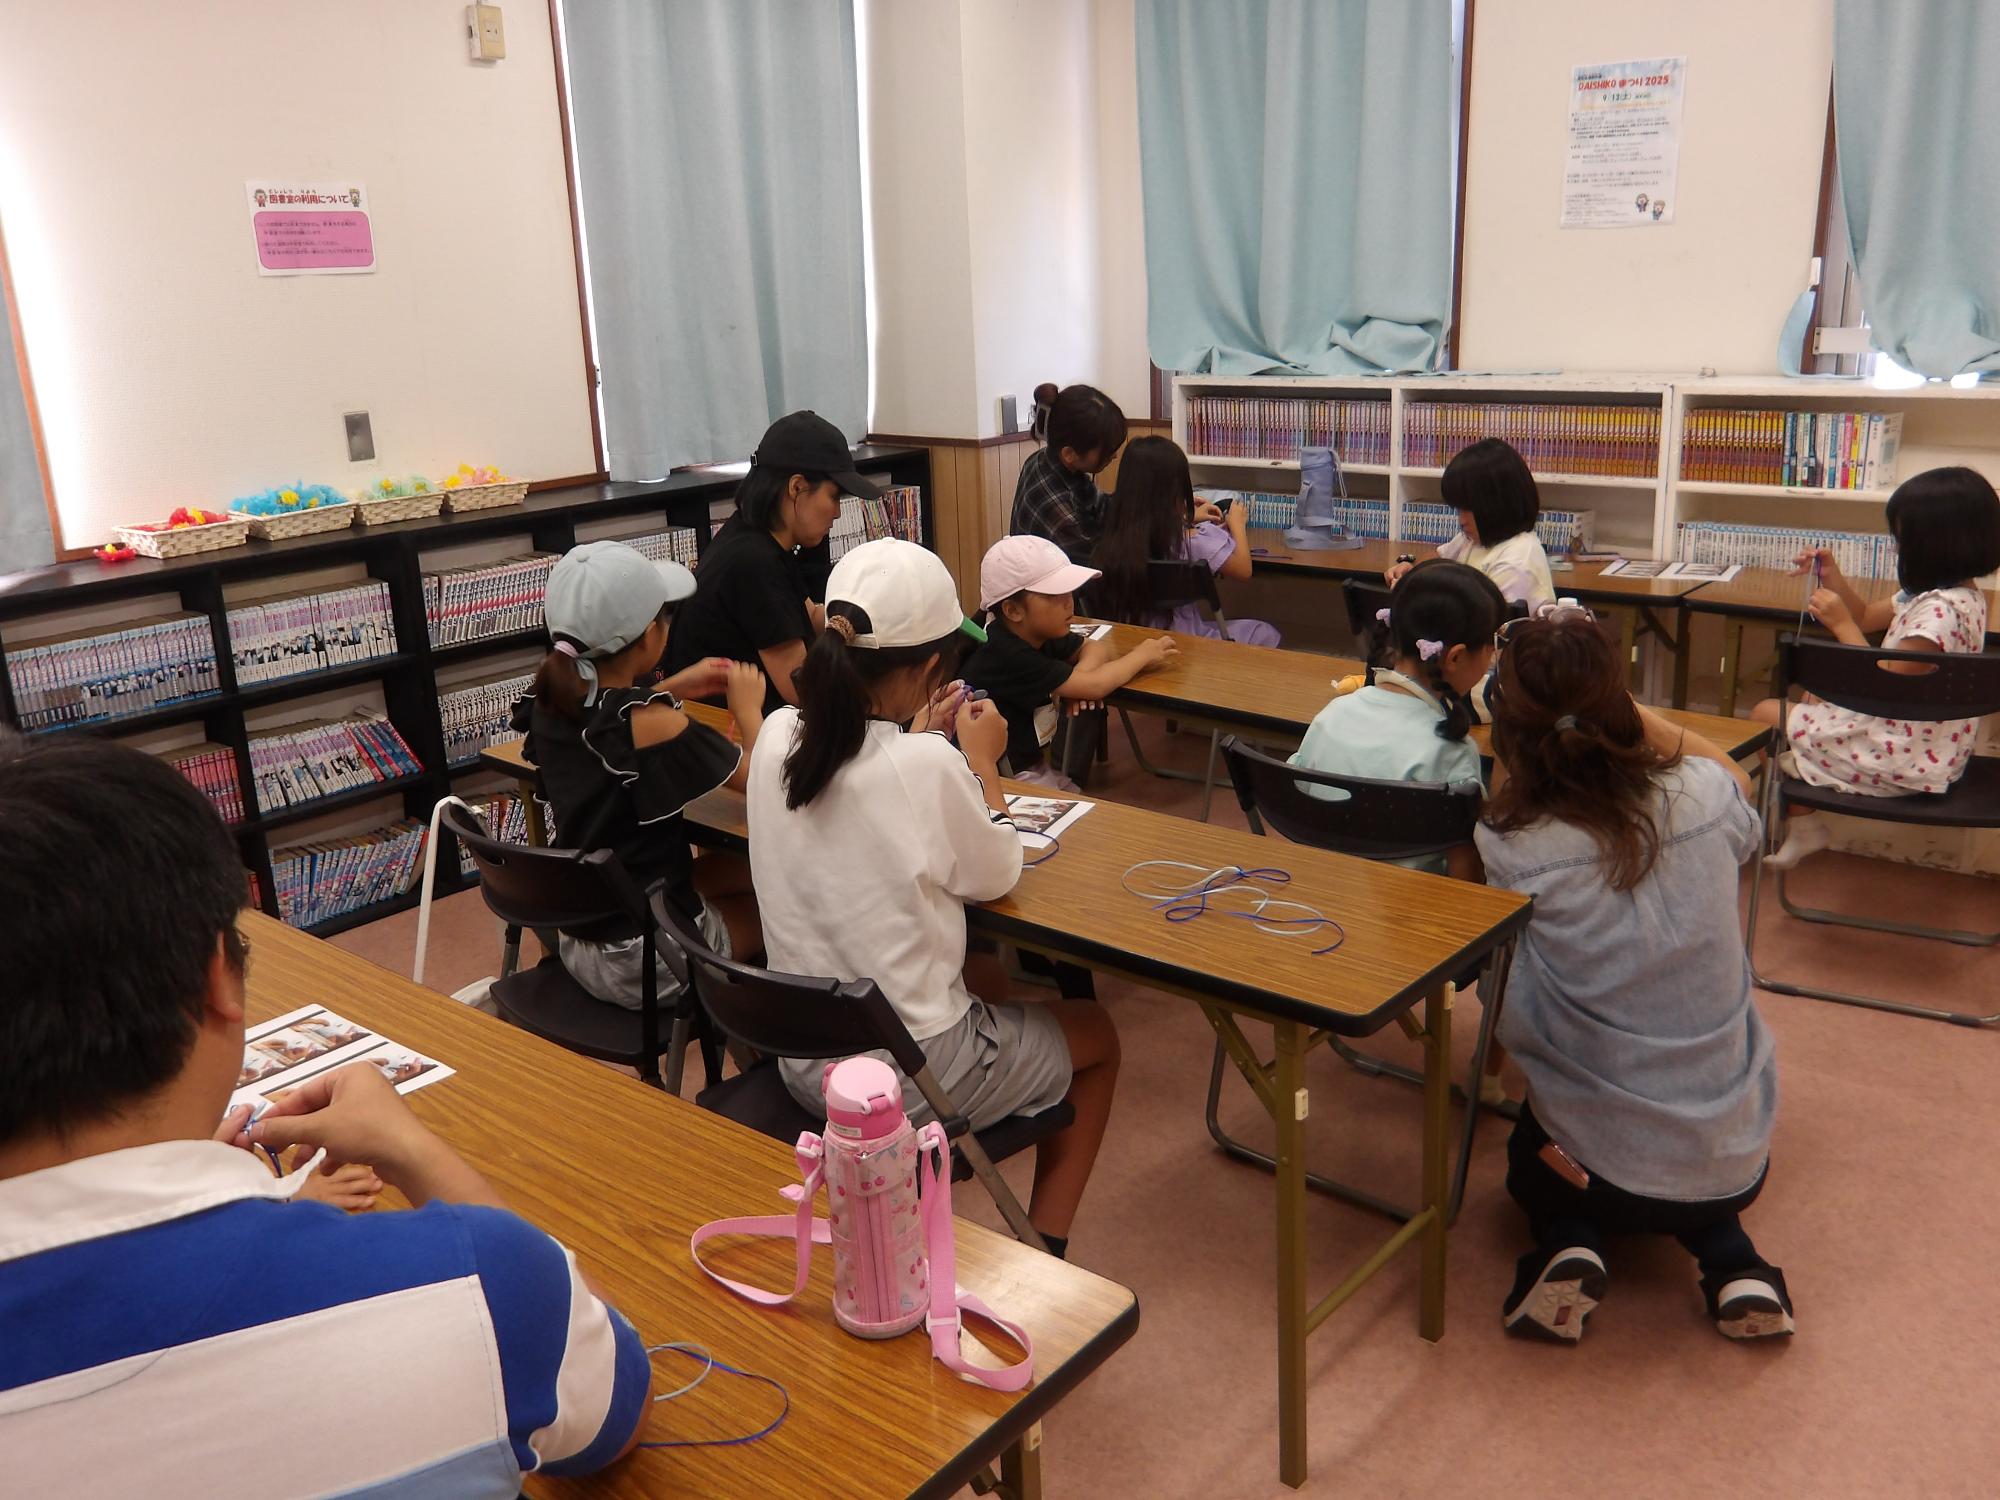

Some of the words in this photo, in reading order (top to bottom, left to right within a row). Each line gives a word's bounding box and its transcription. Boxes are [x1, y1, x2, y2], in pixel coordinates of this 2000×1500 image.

[1645, 75, 1669, 86] 2025
[269, 194, 349, 204] 図書室の利用について
